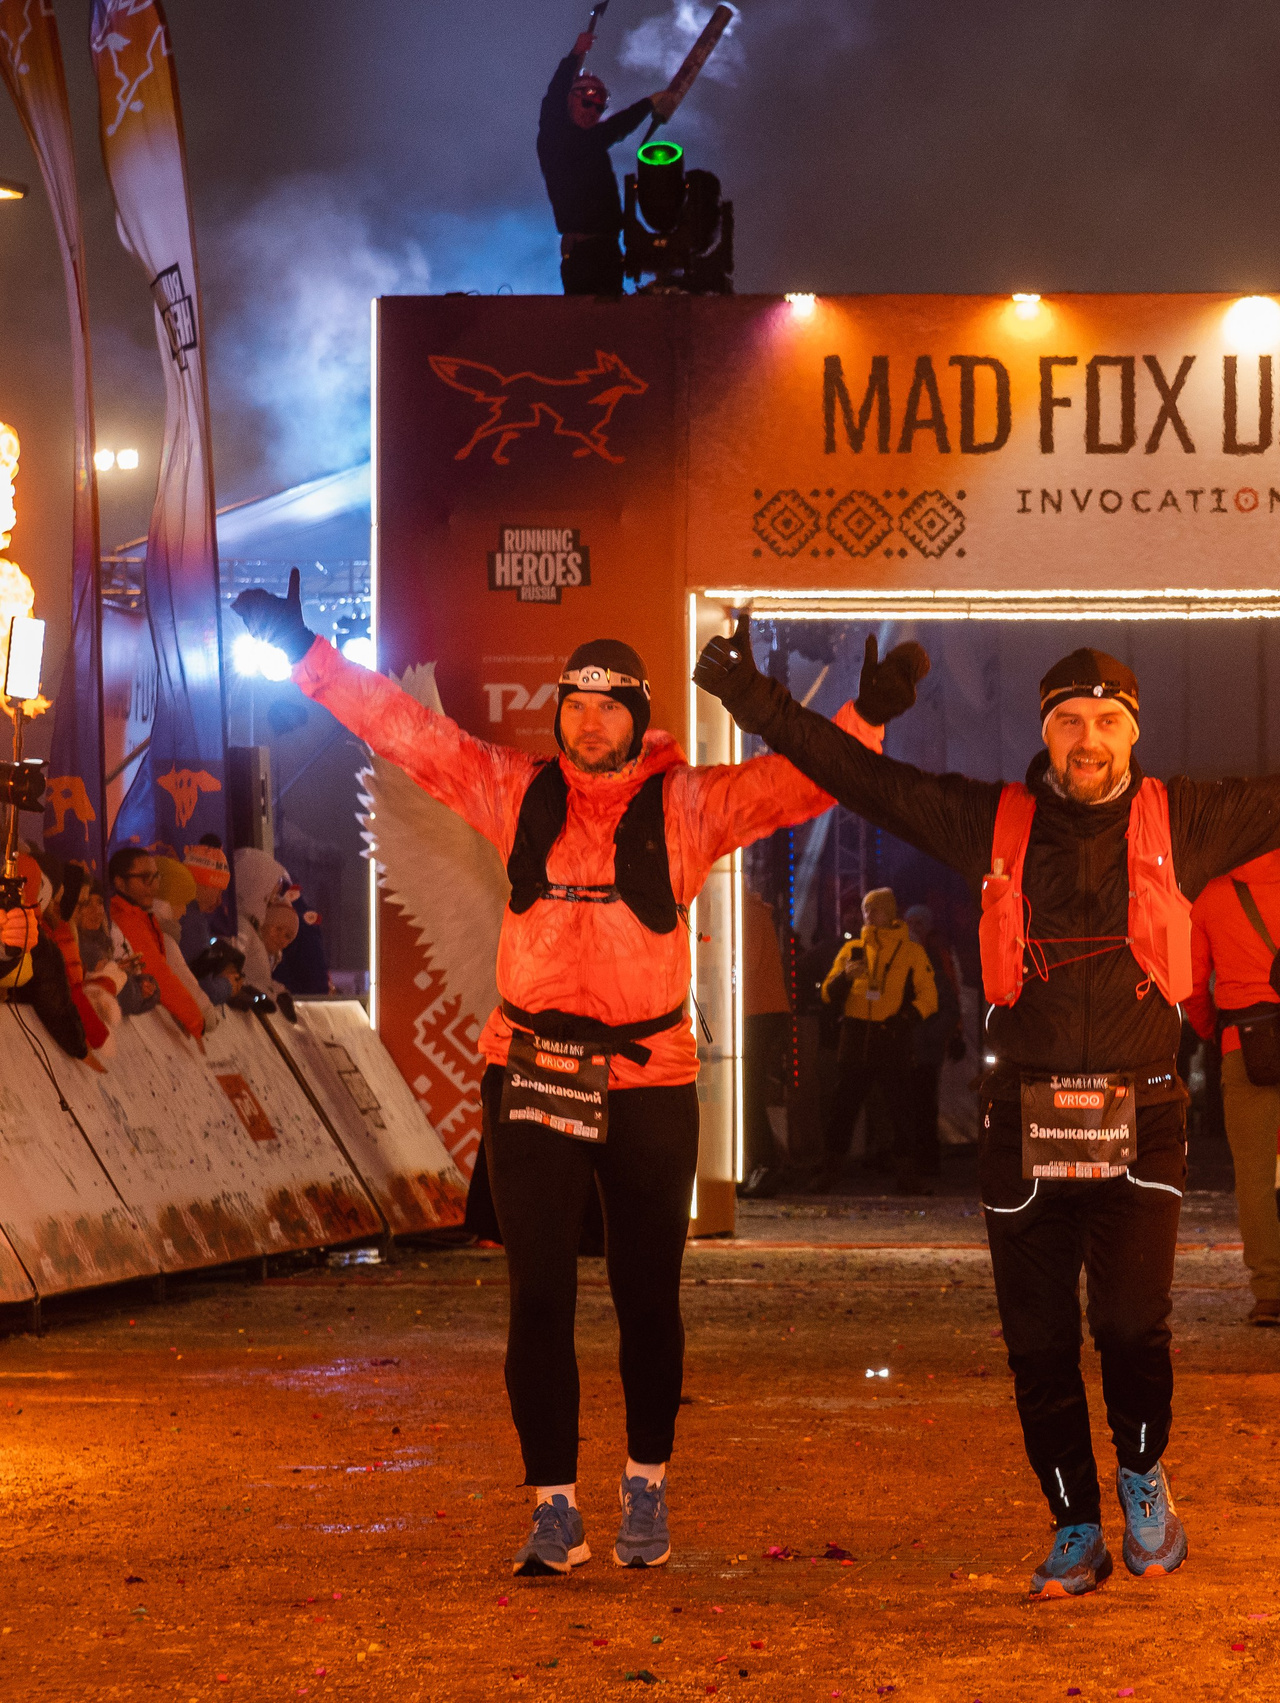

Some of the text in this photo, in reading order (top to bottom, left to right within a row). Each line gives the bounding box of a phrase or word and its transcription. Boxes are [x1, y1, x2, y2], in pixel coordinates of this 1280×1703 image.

[822, 354, 1013, 455] MAD
[1038, 354, 1198, 455] FOX
[503, 528, 574, 552] RUNNING
[494, 551, 583, 587] HEROES
[520, 585, 558, 601] RUSSIA
[511, 1073, 602, 1104] Замыкающий
[1029, 1122, 1130, 1142] Замыкающий
